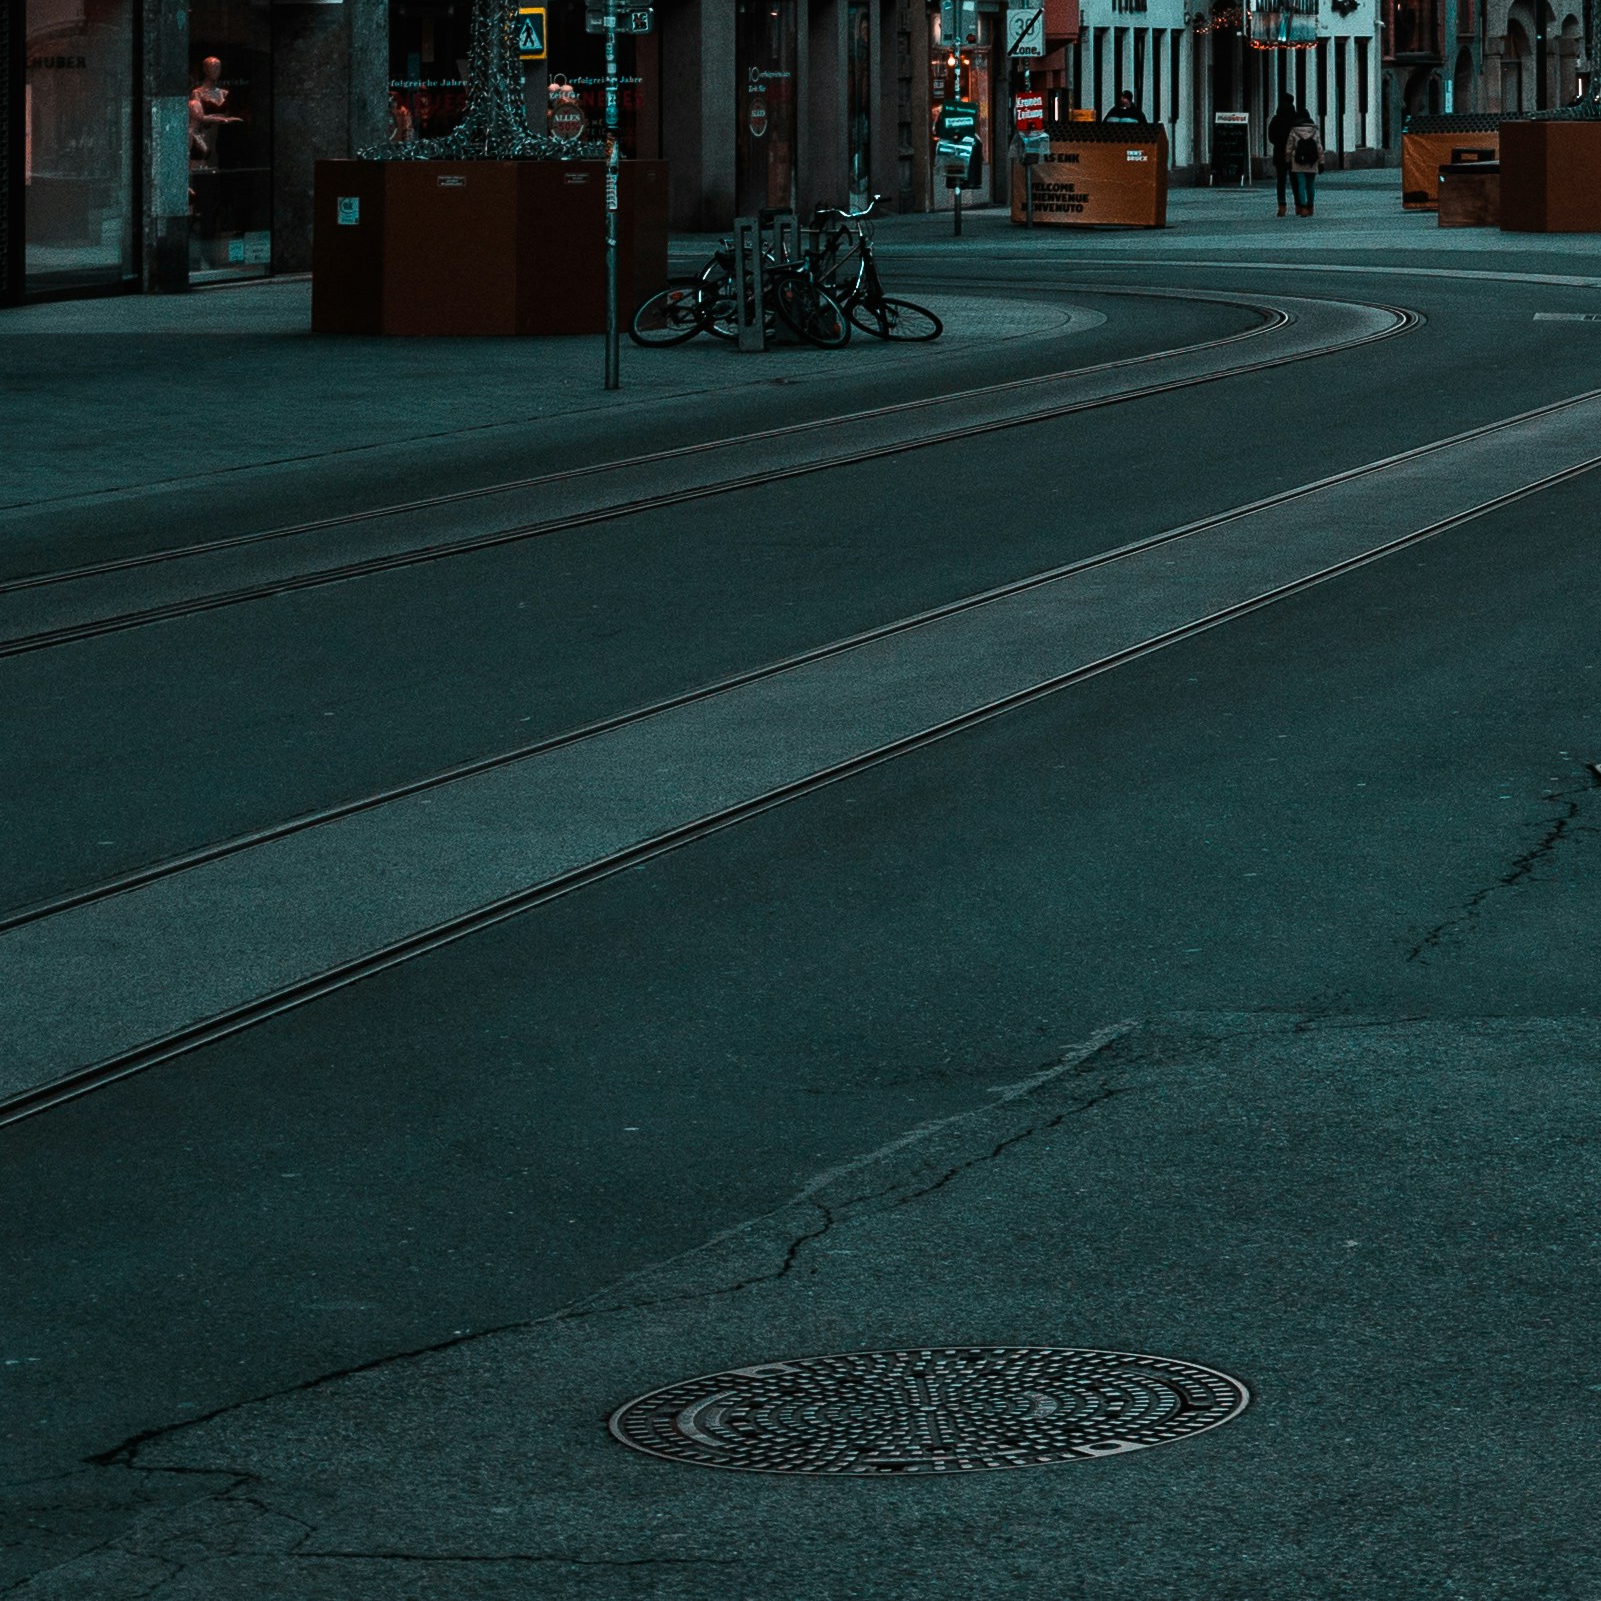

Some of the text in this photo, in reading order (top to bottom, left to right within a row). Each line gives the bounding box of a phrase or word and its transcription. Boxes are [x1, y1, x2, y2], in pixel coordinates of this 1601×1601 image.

[390, 78, 437, 89] folgreiche
[583, 91, 645, 109] NEES
[553, 113, 581, 122] ALLES
[1057, 153, 1080, 163] ENK
